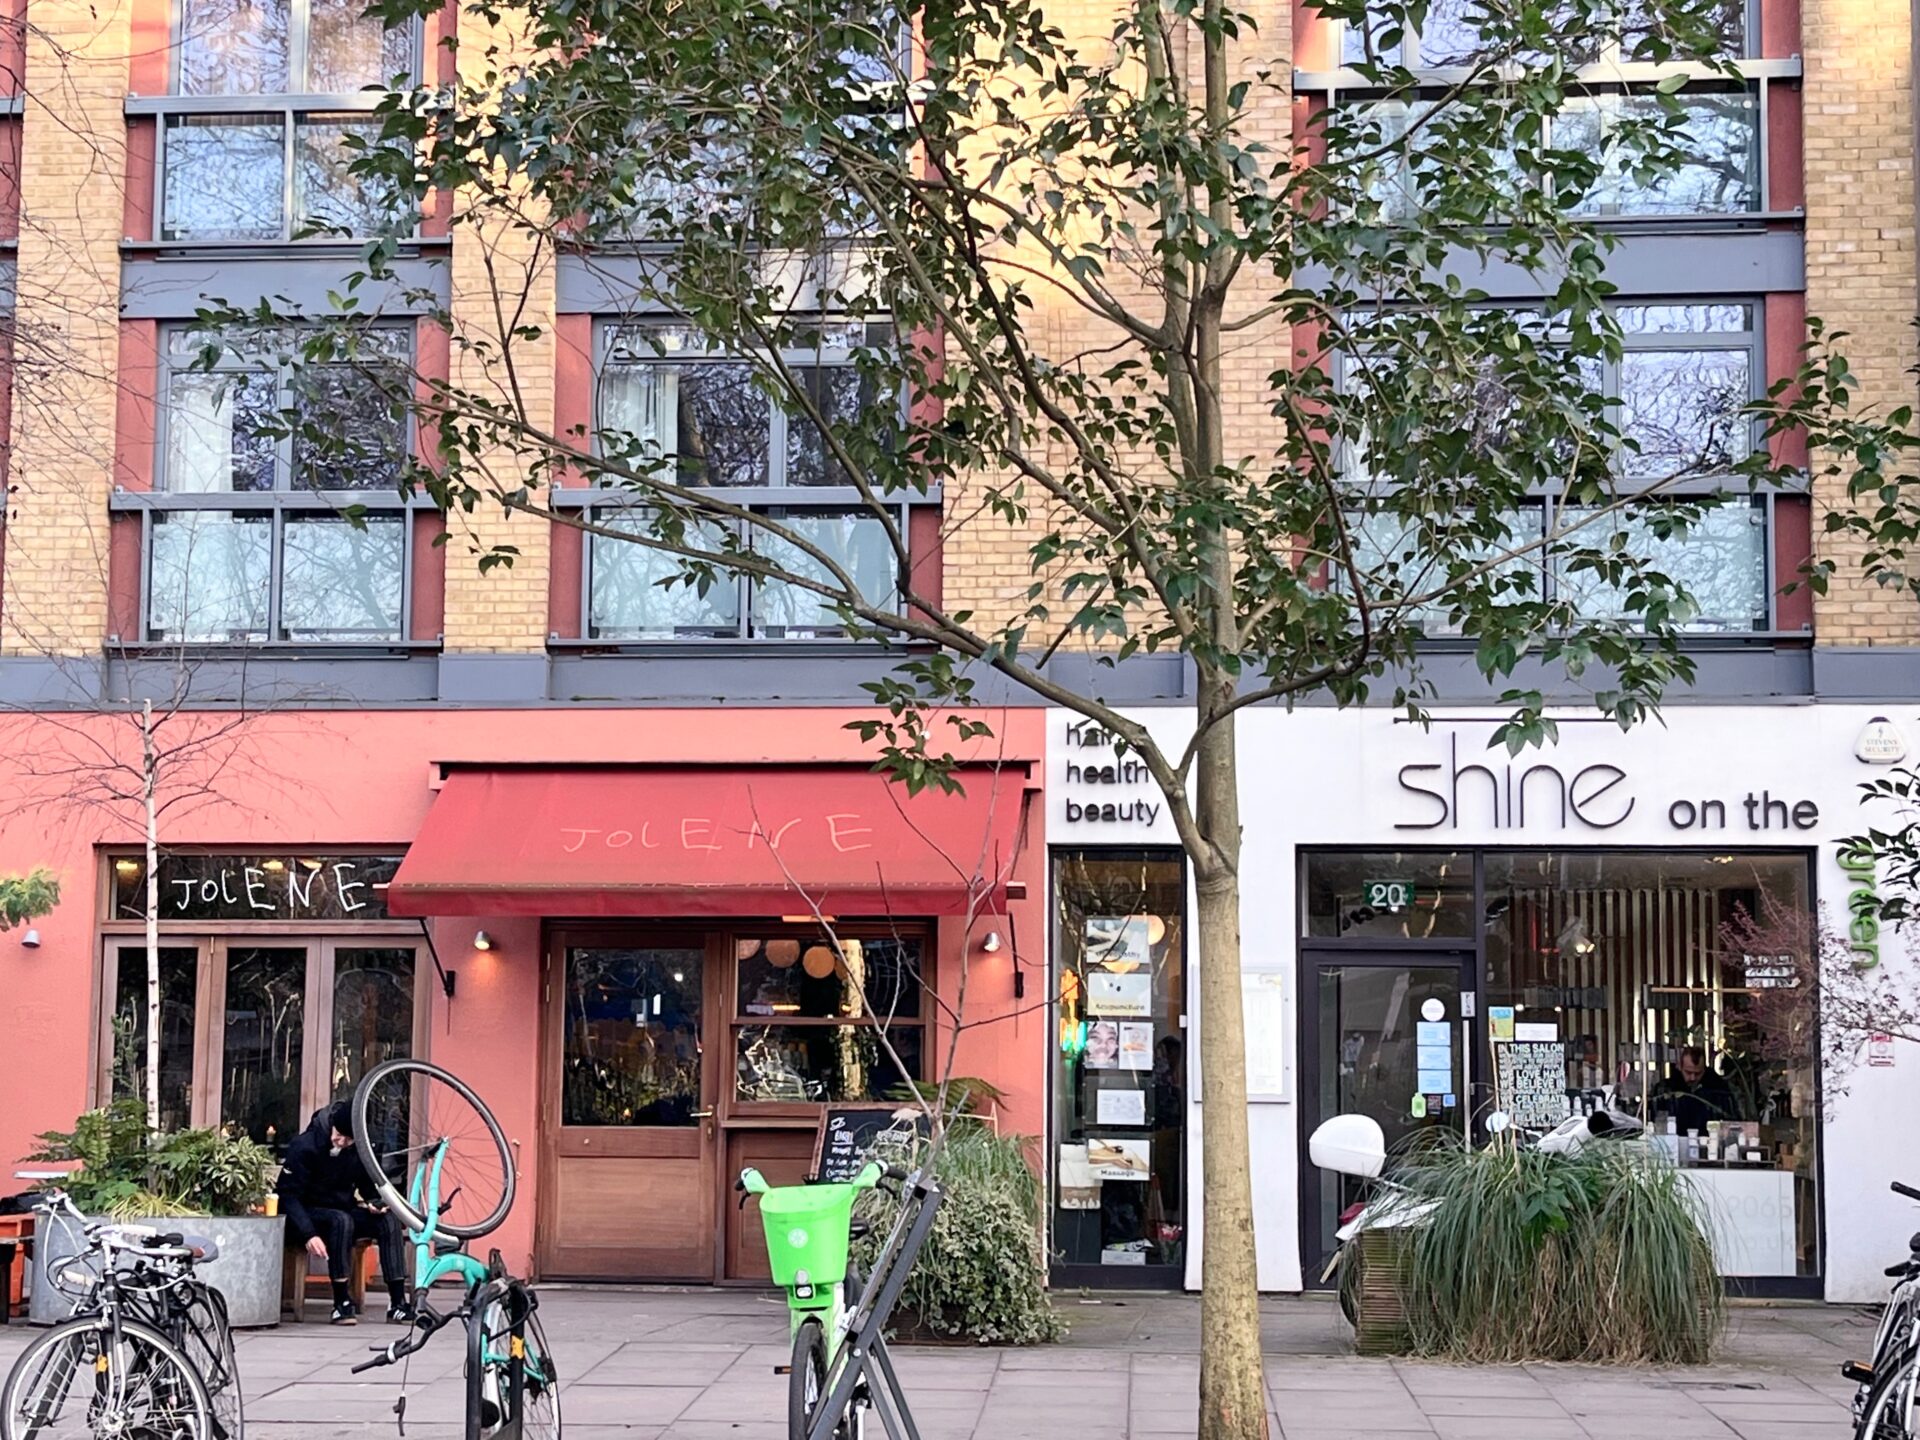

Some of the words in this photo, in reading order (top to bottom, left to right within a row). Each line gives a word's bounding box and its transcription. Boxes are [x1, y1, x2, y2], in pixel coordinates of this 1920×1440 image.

[1066, 760, 1150, 784] health
[1393, 731, 1636, 830] shine
[1668, 799, 1726, 830] on
[1742, 789, 1819, 830] the
[1066, 797, 1160, 826] beauty
[559, 813, 873, 853] JOLENE
[171, 863, 367, 912] JOLENE
[1371, 884, 1405, 907] 20
[1509, 1043, 1531, 1053] THIS
[1532, 1043, 1565, 1053] SALON
[1516, 1070, 1541, 1079] LOVE
[1516, 1080, 1555, 1089] BELIEVE
[1556, 1080, 1566, 1089] IN
[1101, 1169, 1136, 1178] Massage
